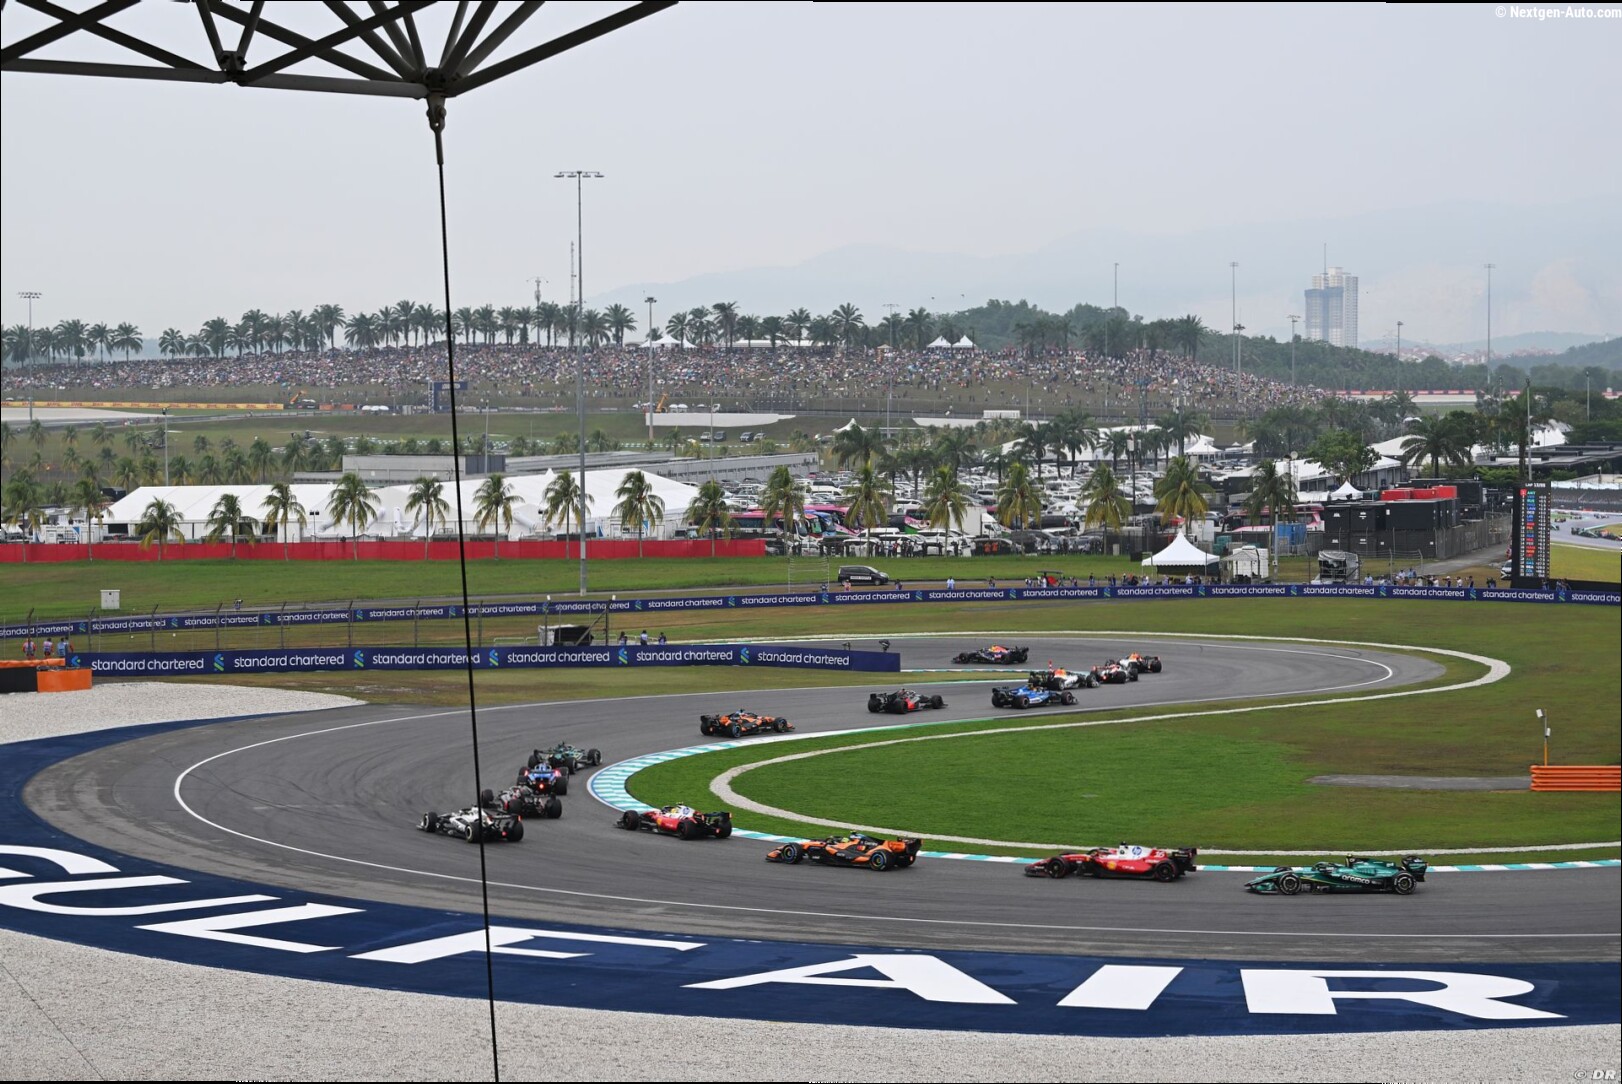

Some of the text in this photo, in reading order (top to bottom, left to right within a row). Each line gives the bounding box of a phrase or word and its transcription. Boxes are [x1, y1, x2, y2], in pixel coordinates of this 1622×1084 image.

[835, 592, 910, 601] standard chartered
[929, 590, 1004, 599] standard chartered
[1023, 588, 1098, 597] standard chartered
[1117, 588, 1153, 596] standard
[1392, 588, 1464, 597] standard chartered
[1482, 590, 1554, 600] standard chartered
[648, 598, 723, 608] standard chartered
[741, 595, 816, 605] standard chartered
[369, 609, 404, 617] standard
[372, 654, 425, 664] standard
[507, 651, 610, 663] standard chartered
[636, 650, 733, 661] standard chartered
[757, 652, 850, 666] standard chartered
[91, 658, 204, 671] standard chartered
[234, 654, 345, 668] standard chartered
[1342, 874, 1370, 885] aramco
[680, 953, 1569, 1020] AIR
